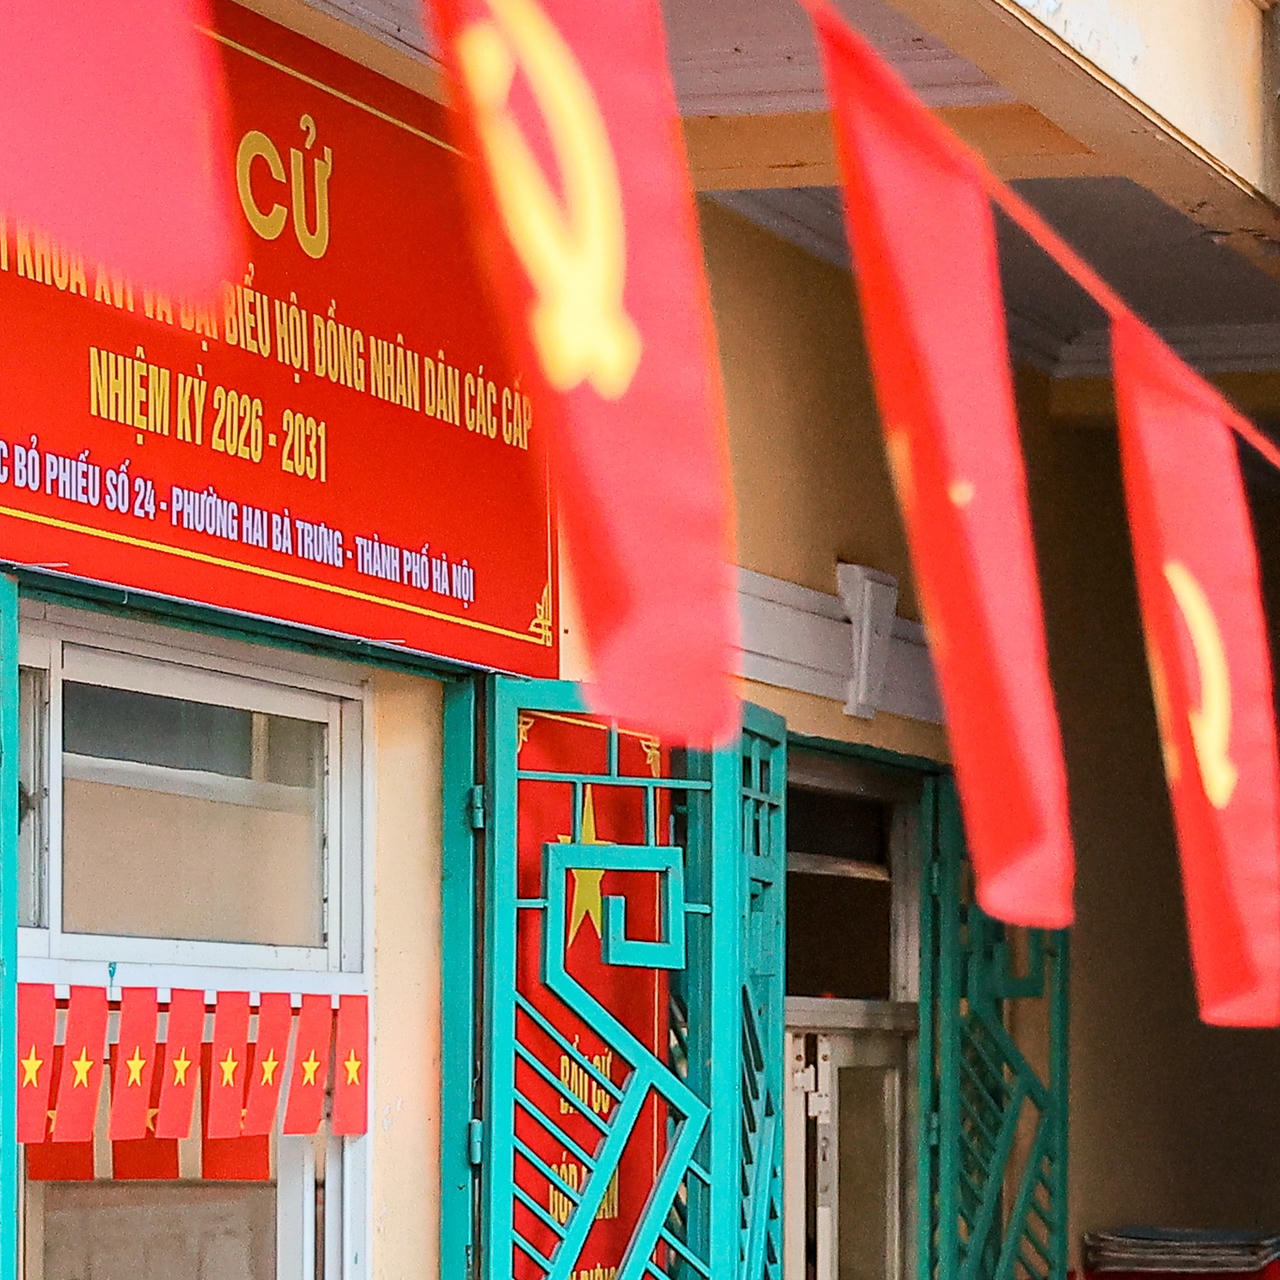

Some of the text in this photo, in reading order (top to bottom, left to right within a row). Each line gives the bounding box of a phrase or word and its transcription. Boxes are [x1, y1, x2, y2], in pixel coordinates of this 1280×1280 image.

[236, 113, 333, 260] CỬ
[89, 346, 326, 482] NHIỆM KỲ 2026 - 2031
[222, 262, 270, 358] BIỂU
[275, 291, 309, 383] HỘI
[313, 299, 365, 392] ĐỒNG
[369, 333, 420, 412] NHÂN
[424, 350, 460, 426] DÂN
[464, 365, 497, 439] CÁC
[14, 435, 40, 492] BỎ
[45, 450, 100, 507] PHIẾU
[105, 459, 129, 514] SỐ
[133, 477, 156, 520] 24
[160, 501, 168, 511] -
[171, 486, 238, 541] PHƯỜNG
[242, 505, 268, 549] HAI
[271, 508, 293, 555] BÀ
[296, 519, 344, 568] TRƯNG
[355, 533, 401, 583] THÀNH
[403, 543, 430, 591] PHỐ
[431, 553, 450, 596] HÀ
[451, 559, 475, 609] NỘI
